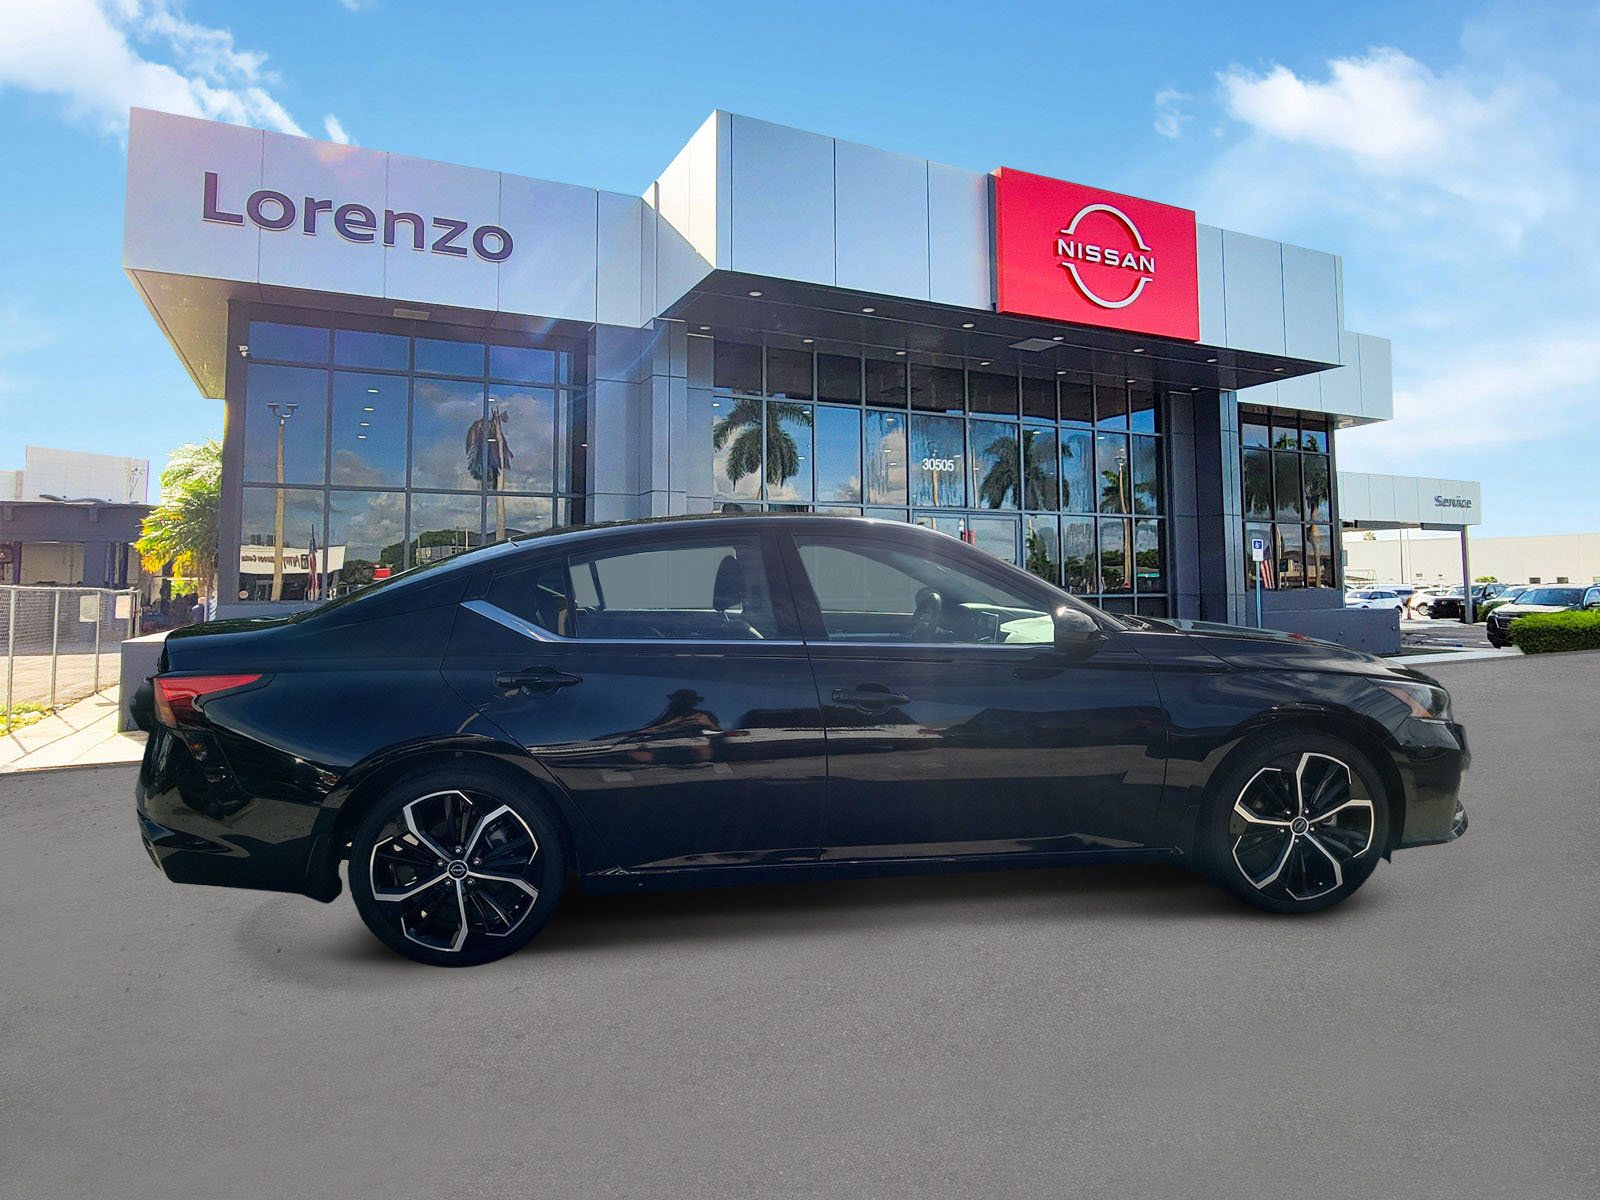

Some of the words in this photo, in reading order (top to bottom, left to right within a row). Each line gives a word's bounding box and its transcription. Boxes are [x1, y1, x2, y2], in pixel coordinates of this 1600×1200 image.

[202, 171, 514, 262] Lorenzo
[1056, 238, 1156, 273] NISSAN
[921, 457, 955, 472] 30505
[1433, 495, 1473, 509] Service
